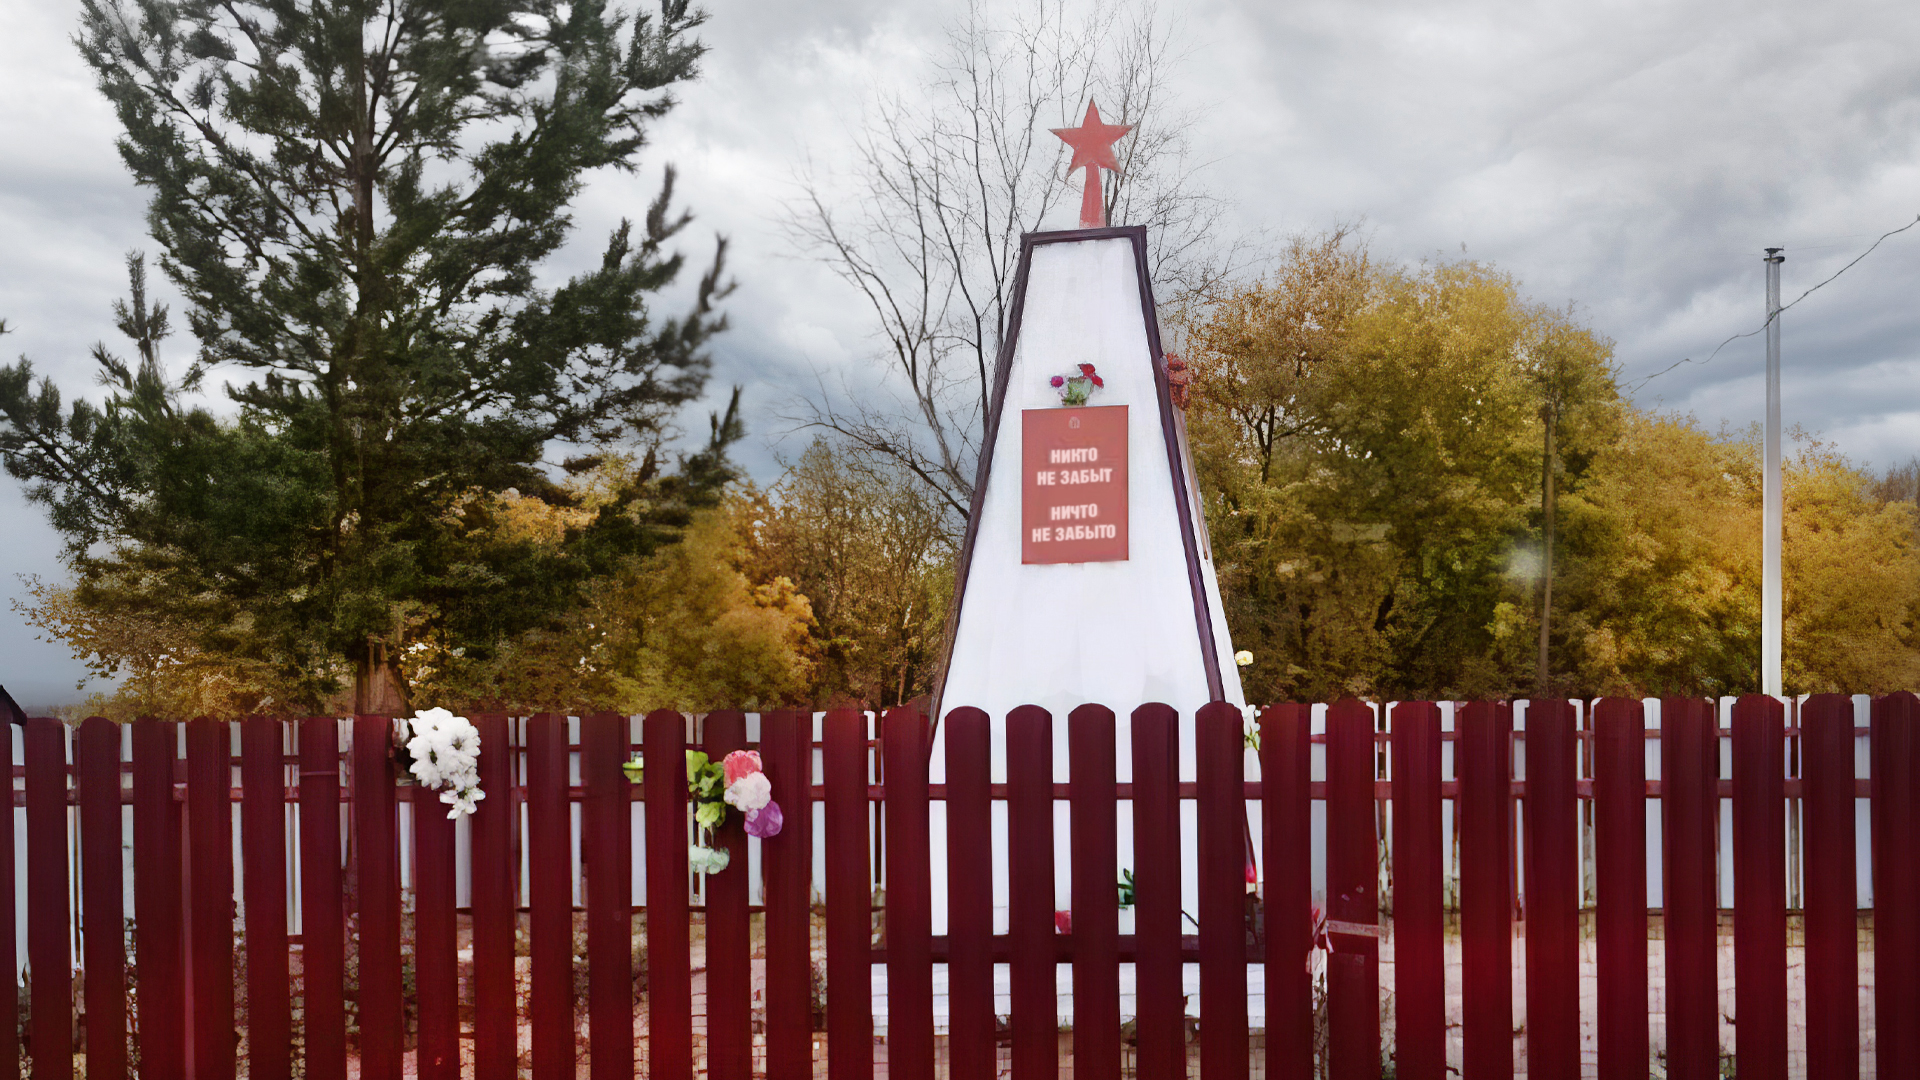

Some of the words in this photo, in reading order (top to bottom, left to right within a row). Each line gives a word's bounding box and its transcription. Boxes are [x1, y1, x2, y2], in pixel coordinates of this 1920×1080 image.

[1050, 447, 1098, 464] НИКТО
[1037, 471, 1056, 486] НЕ
[1060, 468, 1113, 485] ЗАБЫТ
[1050, 503, 1098, 521] НИЧТО
[1032, 527, 1051, 543] НЕ
[1055, 524, 1116, 542] ЗАБЫТО
